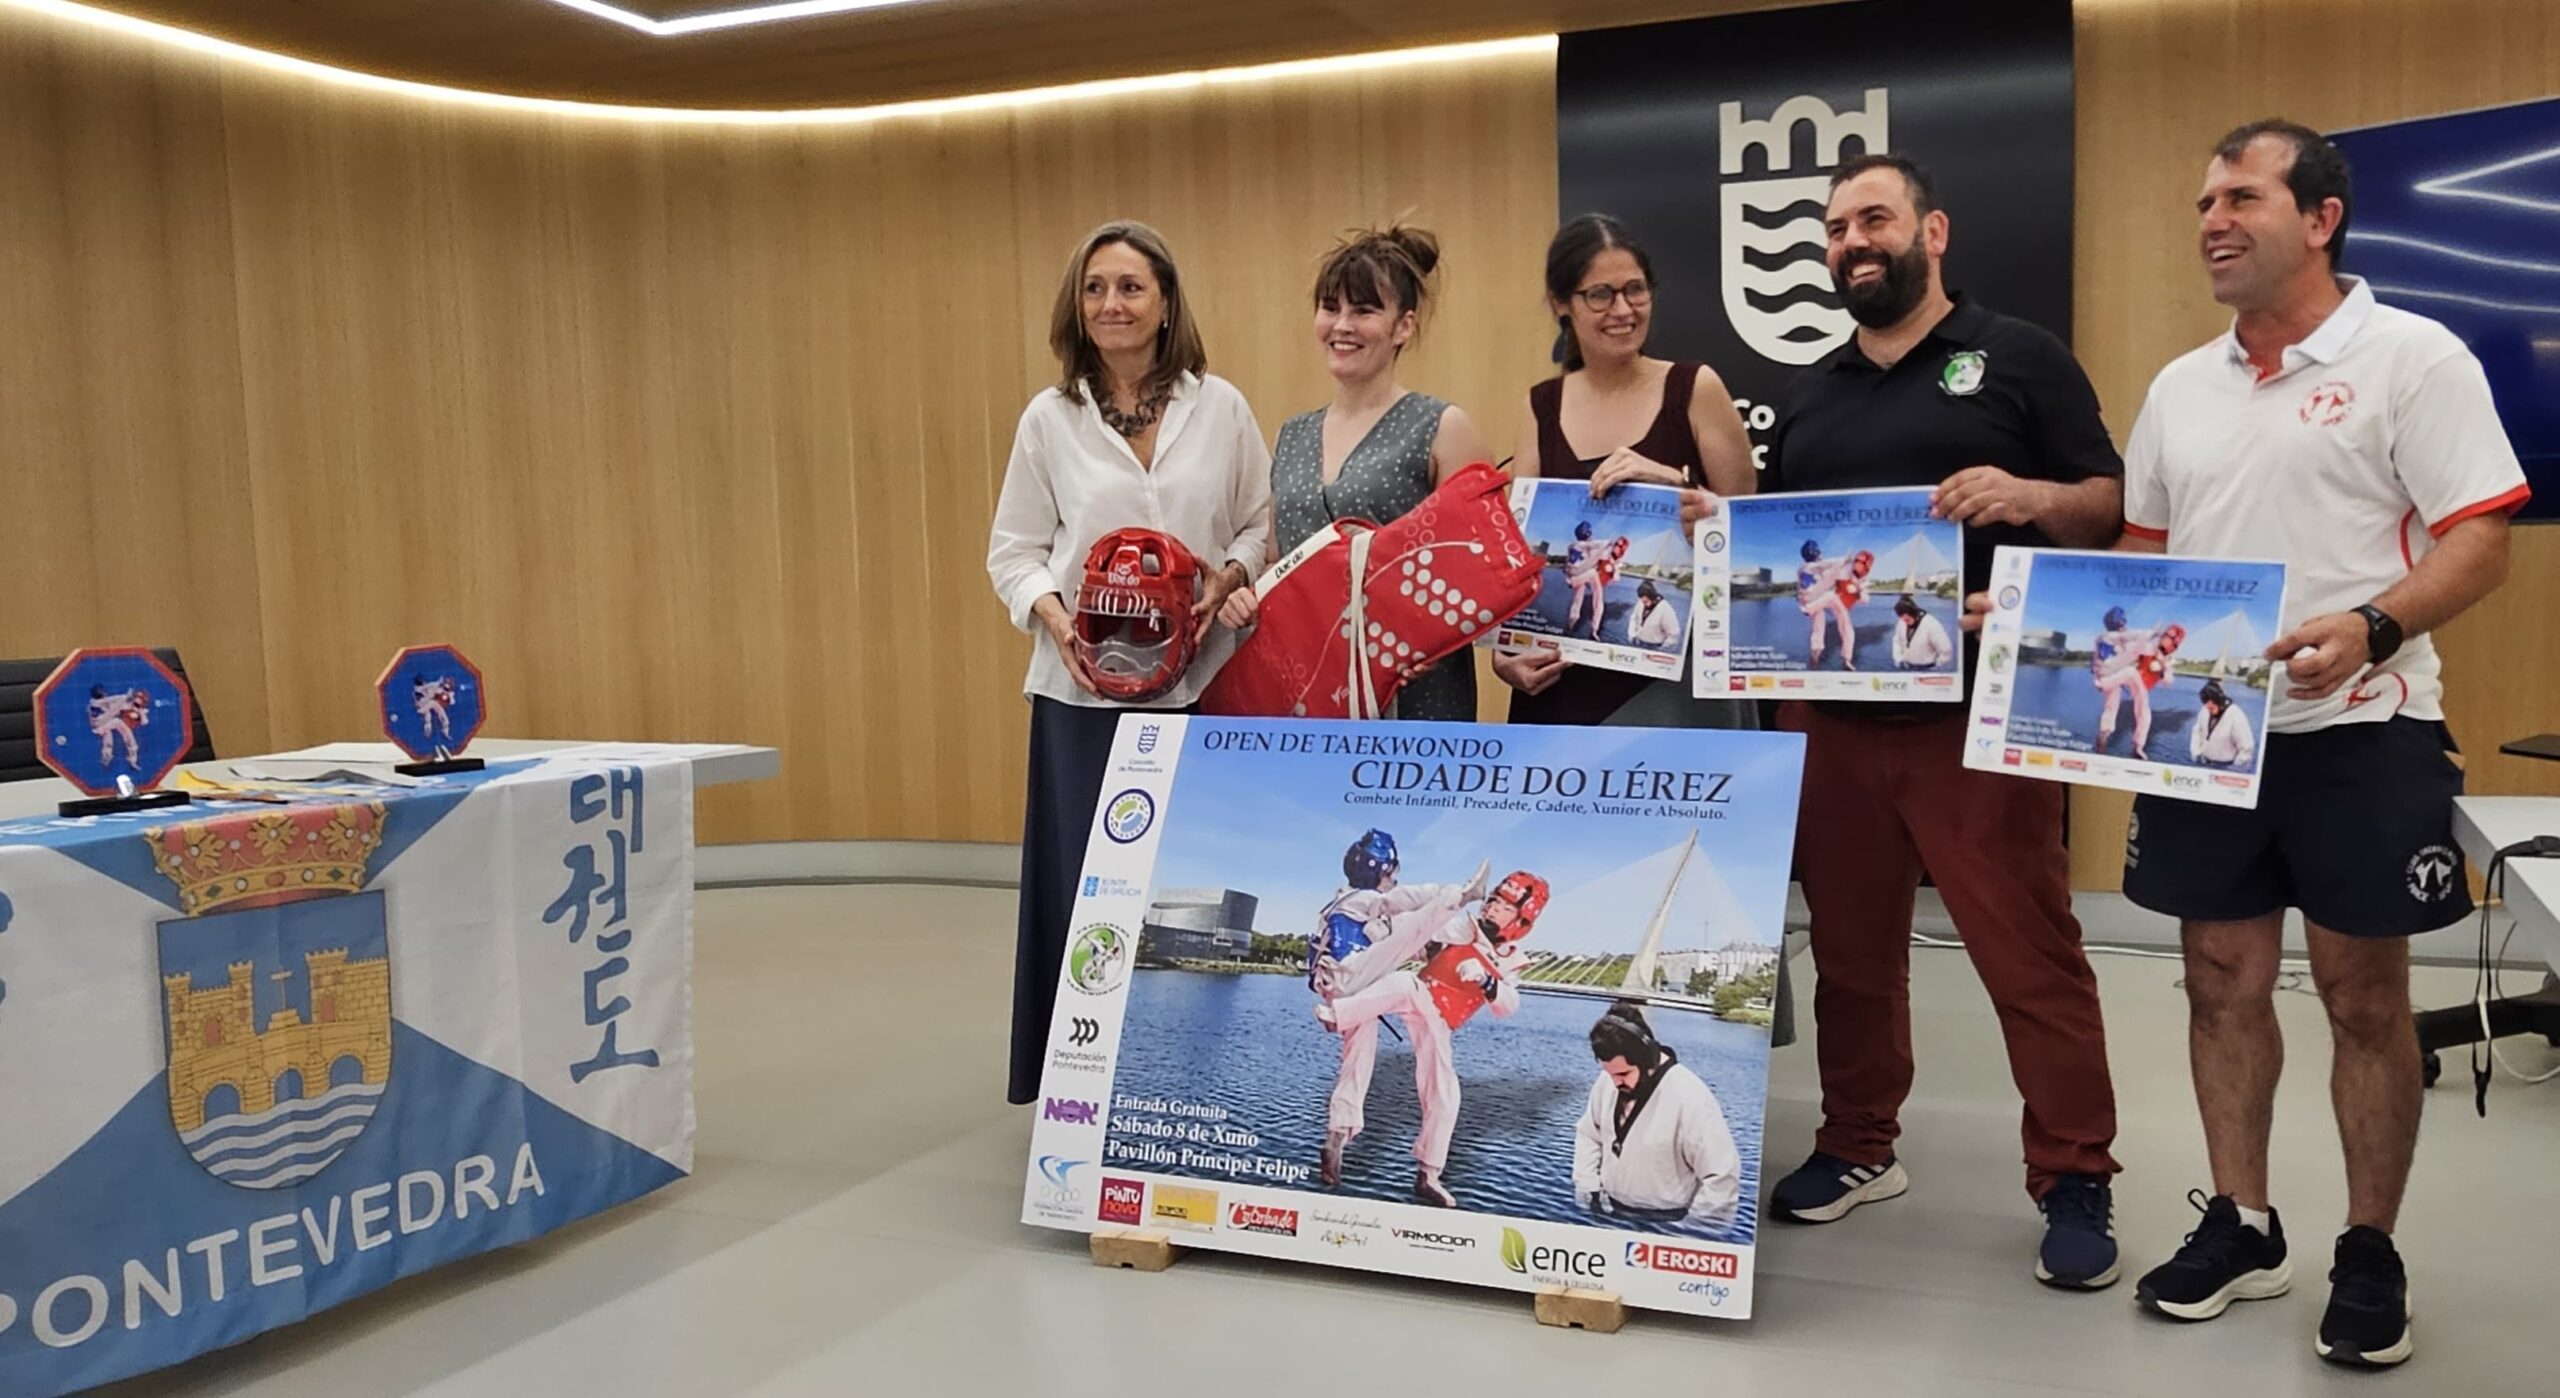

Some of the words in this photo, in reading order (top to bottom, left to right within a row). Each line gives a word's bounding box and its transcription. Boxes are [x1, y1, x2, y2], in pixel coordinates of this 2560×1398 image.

[1859, 508, 1882, 522] DO
[2105, 577, 2171, 592] CIDADE
[2174, 578, 2201, 593] DO
[1204, 730, 1273, 751] OPEN
[1279, 732, 1316, 753] DE
[1321, 733, 1504, 760] TAEKWONDO
[1352, 760, 1513, 795] CIDADE
[1522, 766, 1587, 797] DO
[1599, 761, 1734, 804] LÉREZ
[1343, 791, 1401, 806] Combate
[1405, 794, 1459, 810] Infantil,
[1463, 796, 1532, 812] Precadete,
[1535, 799, 1587, 815] Cadete,
[1592, 801, 1640, 816] Xunior
[1644, 807, 1653, 816] e
[1656, 804, 1727, 820] Absoluto.
[1052, 1060, 1106, 1073] Pontevedra
[1053, 1048, 1107, 1062] Deputación
[1115, 1094, 1168, 1113] Entrada
[1170, 1099, 1228, 1120] Gratuita
[1111, 1114, 1173, 1138] Sábado
[1175, 1123, 1186, 1137] 8
[1189, 1124, 1210, 1142] de
[1107, 1140, 1178, 1164] Pavillón
[1180, 1148, 1252, 1176] Príncipe
[1255, 1156, 1310, 1184] Felipe
[1532, 1246, 1606, 1277] ence
[1657, 1252, 1732, 1275] EROSKI
[1678, 1279, 1730, 1306] contigo
